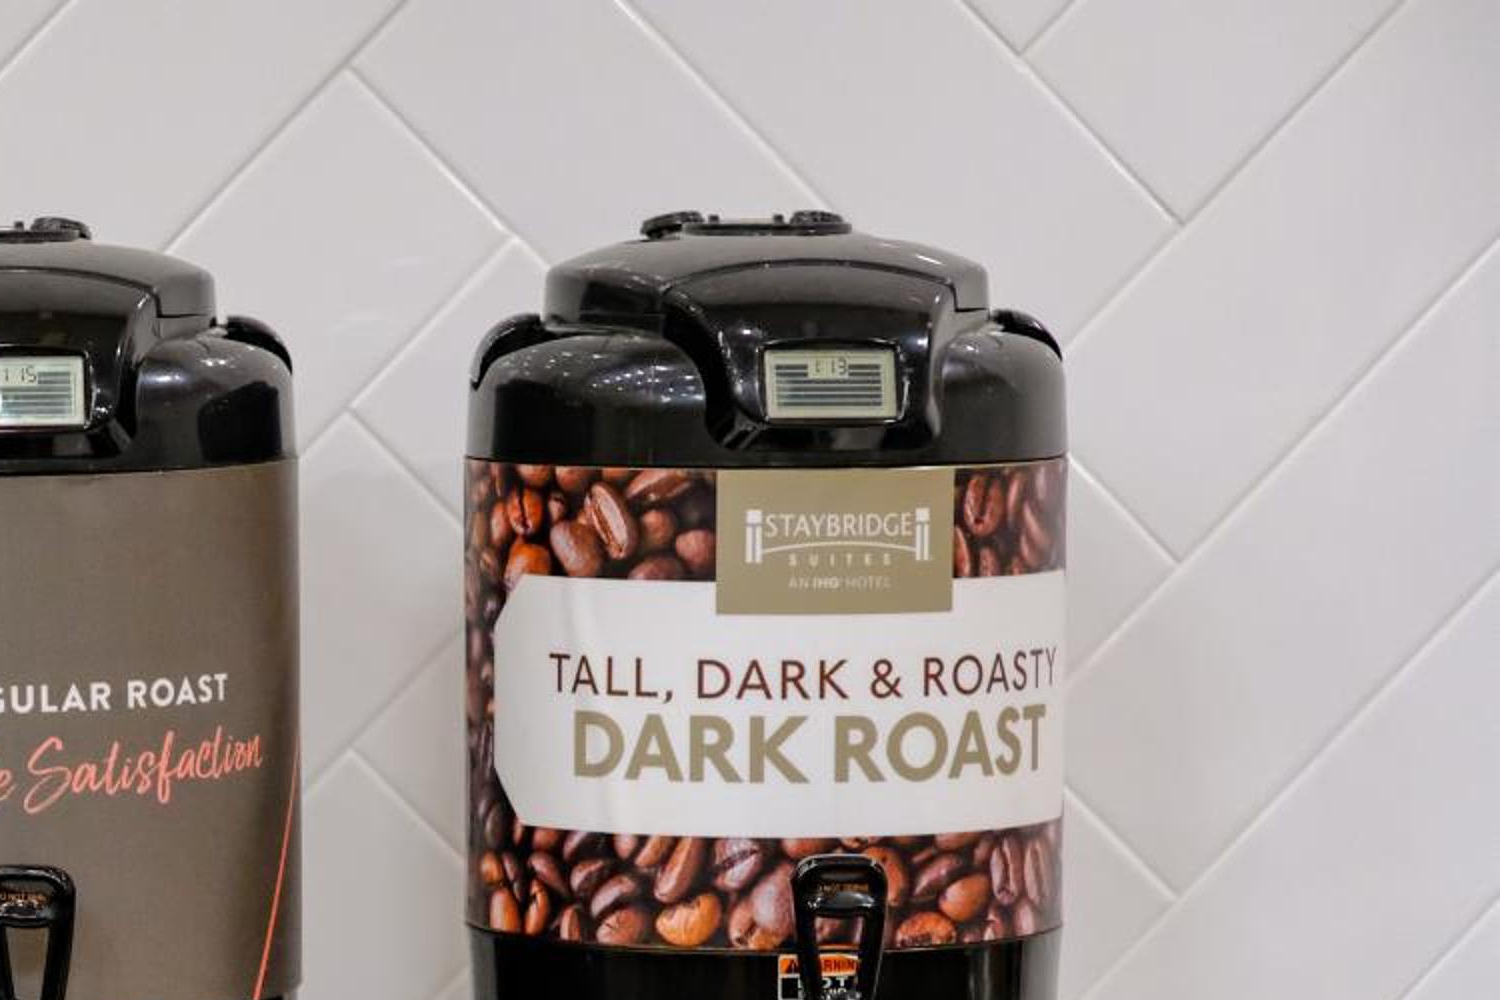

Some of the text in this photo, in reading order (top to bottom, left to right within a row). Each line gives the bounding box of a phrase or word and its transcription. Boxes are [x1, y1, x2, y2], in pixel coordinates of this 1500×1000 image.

[765, 512, 914, 538] STAYBRIDGE
[788, 552, 892, 567] SUITES
[127, 672, 230, 709] ROAST
[549, 646, 1060, 704] TALL, DARK & ROASTY
[573, 703, 1048, 785] DARK ROAST
[23, 725, 264, 816] Satisfaction
